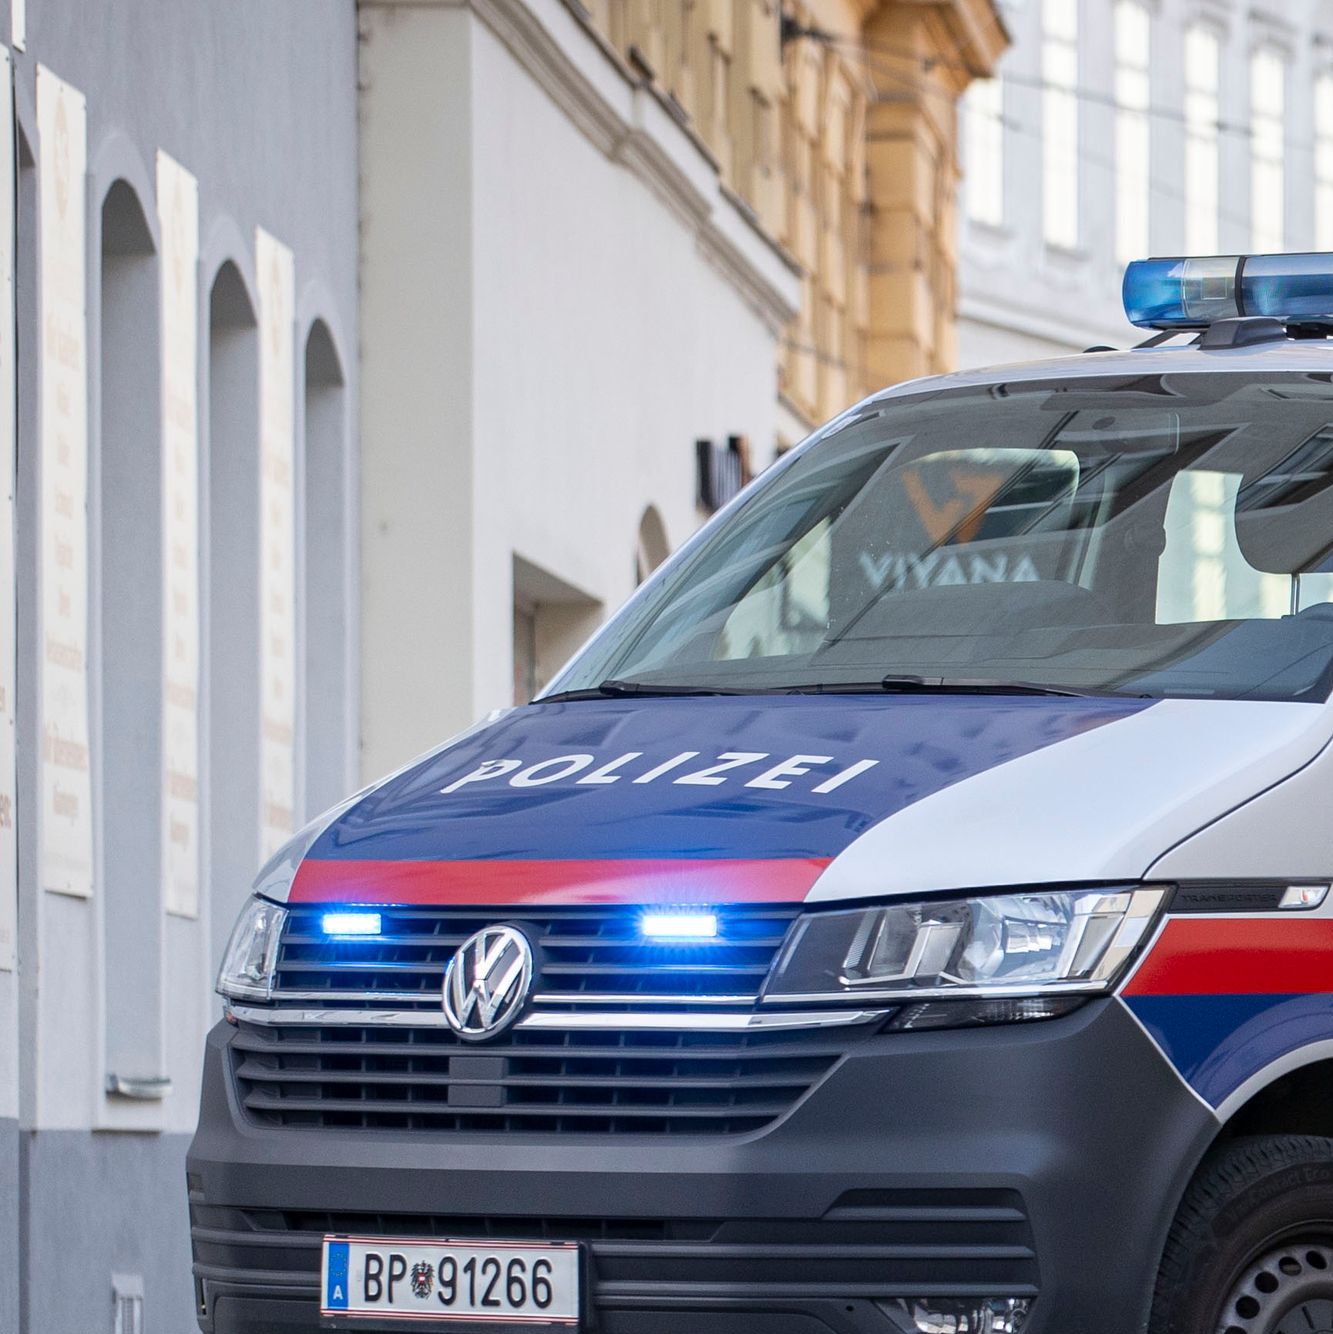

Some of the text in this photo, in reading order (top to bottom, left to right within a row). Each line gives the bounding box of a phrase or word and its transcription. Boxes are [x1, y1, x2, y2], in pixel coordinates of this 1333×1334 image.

[440, 751, 880, 794] POLIZEI
[332, 1285, 343, 1300] A
[364, 1253, 553, 1309] BP 91266
